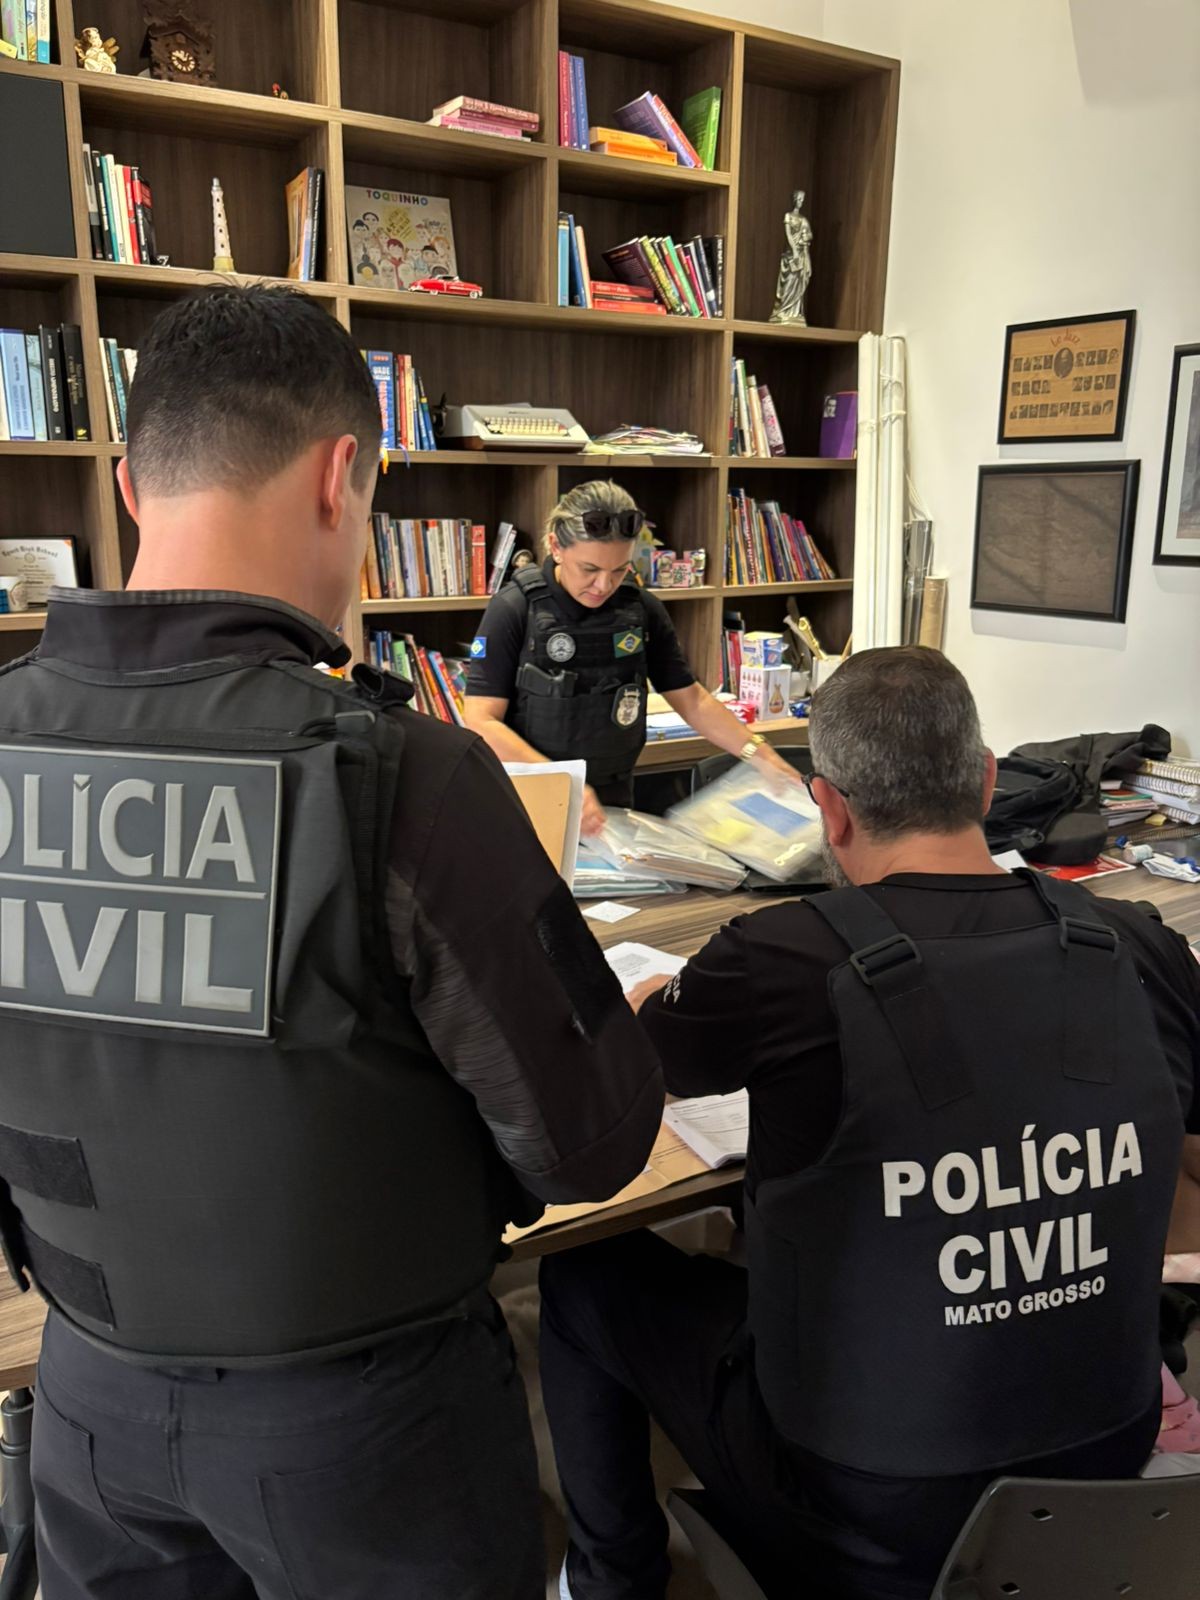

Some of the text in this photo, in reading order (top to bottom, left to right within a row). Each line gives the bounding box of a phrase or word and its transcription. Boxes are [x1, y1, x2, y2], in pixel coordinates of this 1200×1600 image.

[366, 190, 429, 206] TOQUINHO
[0, 774, 256, 883] LÍCIA
[882, 1121, 1143, 1217] POLÍCIA
[938, 1212, 1109, 1295] CIVIL
[944, 1275, 1106, 1326] MATO GROSSO
